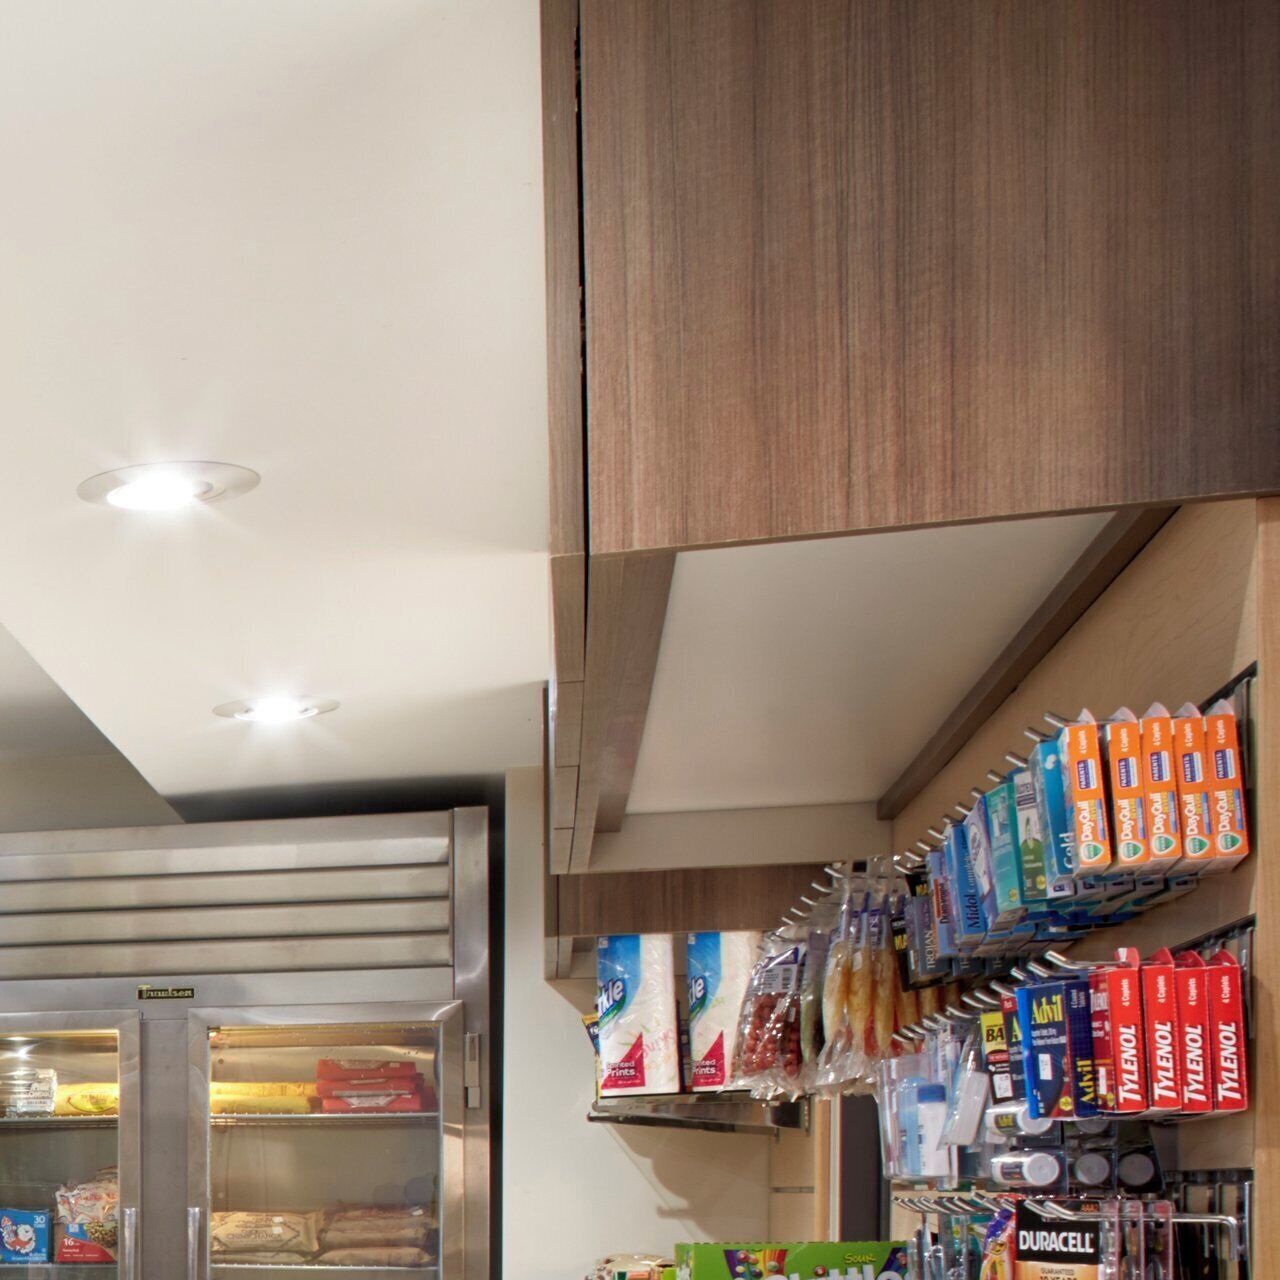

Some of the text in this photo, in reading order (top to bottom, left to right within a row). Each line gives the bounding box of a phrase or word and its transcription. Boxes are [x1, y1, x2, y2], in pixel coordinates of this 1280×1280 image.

[1151, 792, 1167, 834] DayQuil
[1185, 794, 1200, 837] DayQuil
[1218, 789, 1231, 833] DayQuil
[1059, 833, 1073, 868] Cold
[964, 894, 980, 929] Midol
[1031, 993, 1064, 1024] Advil
[606, 1067, 635, 1077] Prints
[1080, 1059, 1097, 1105] Advil
[1118, 1024, 1142, 1103] TYLENOL
[1153, 1020, 1177, 1101] TYLENOL
[1183, 1024, 1208, 1104] TYLENOL
[1217, 1021, 1242, 1103] TYLENOL
[1018, 1229, 1094, 1254] DURACELL
